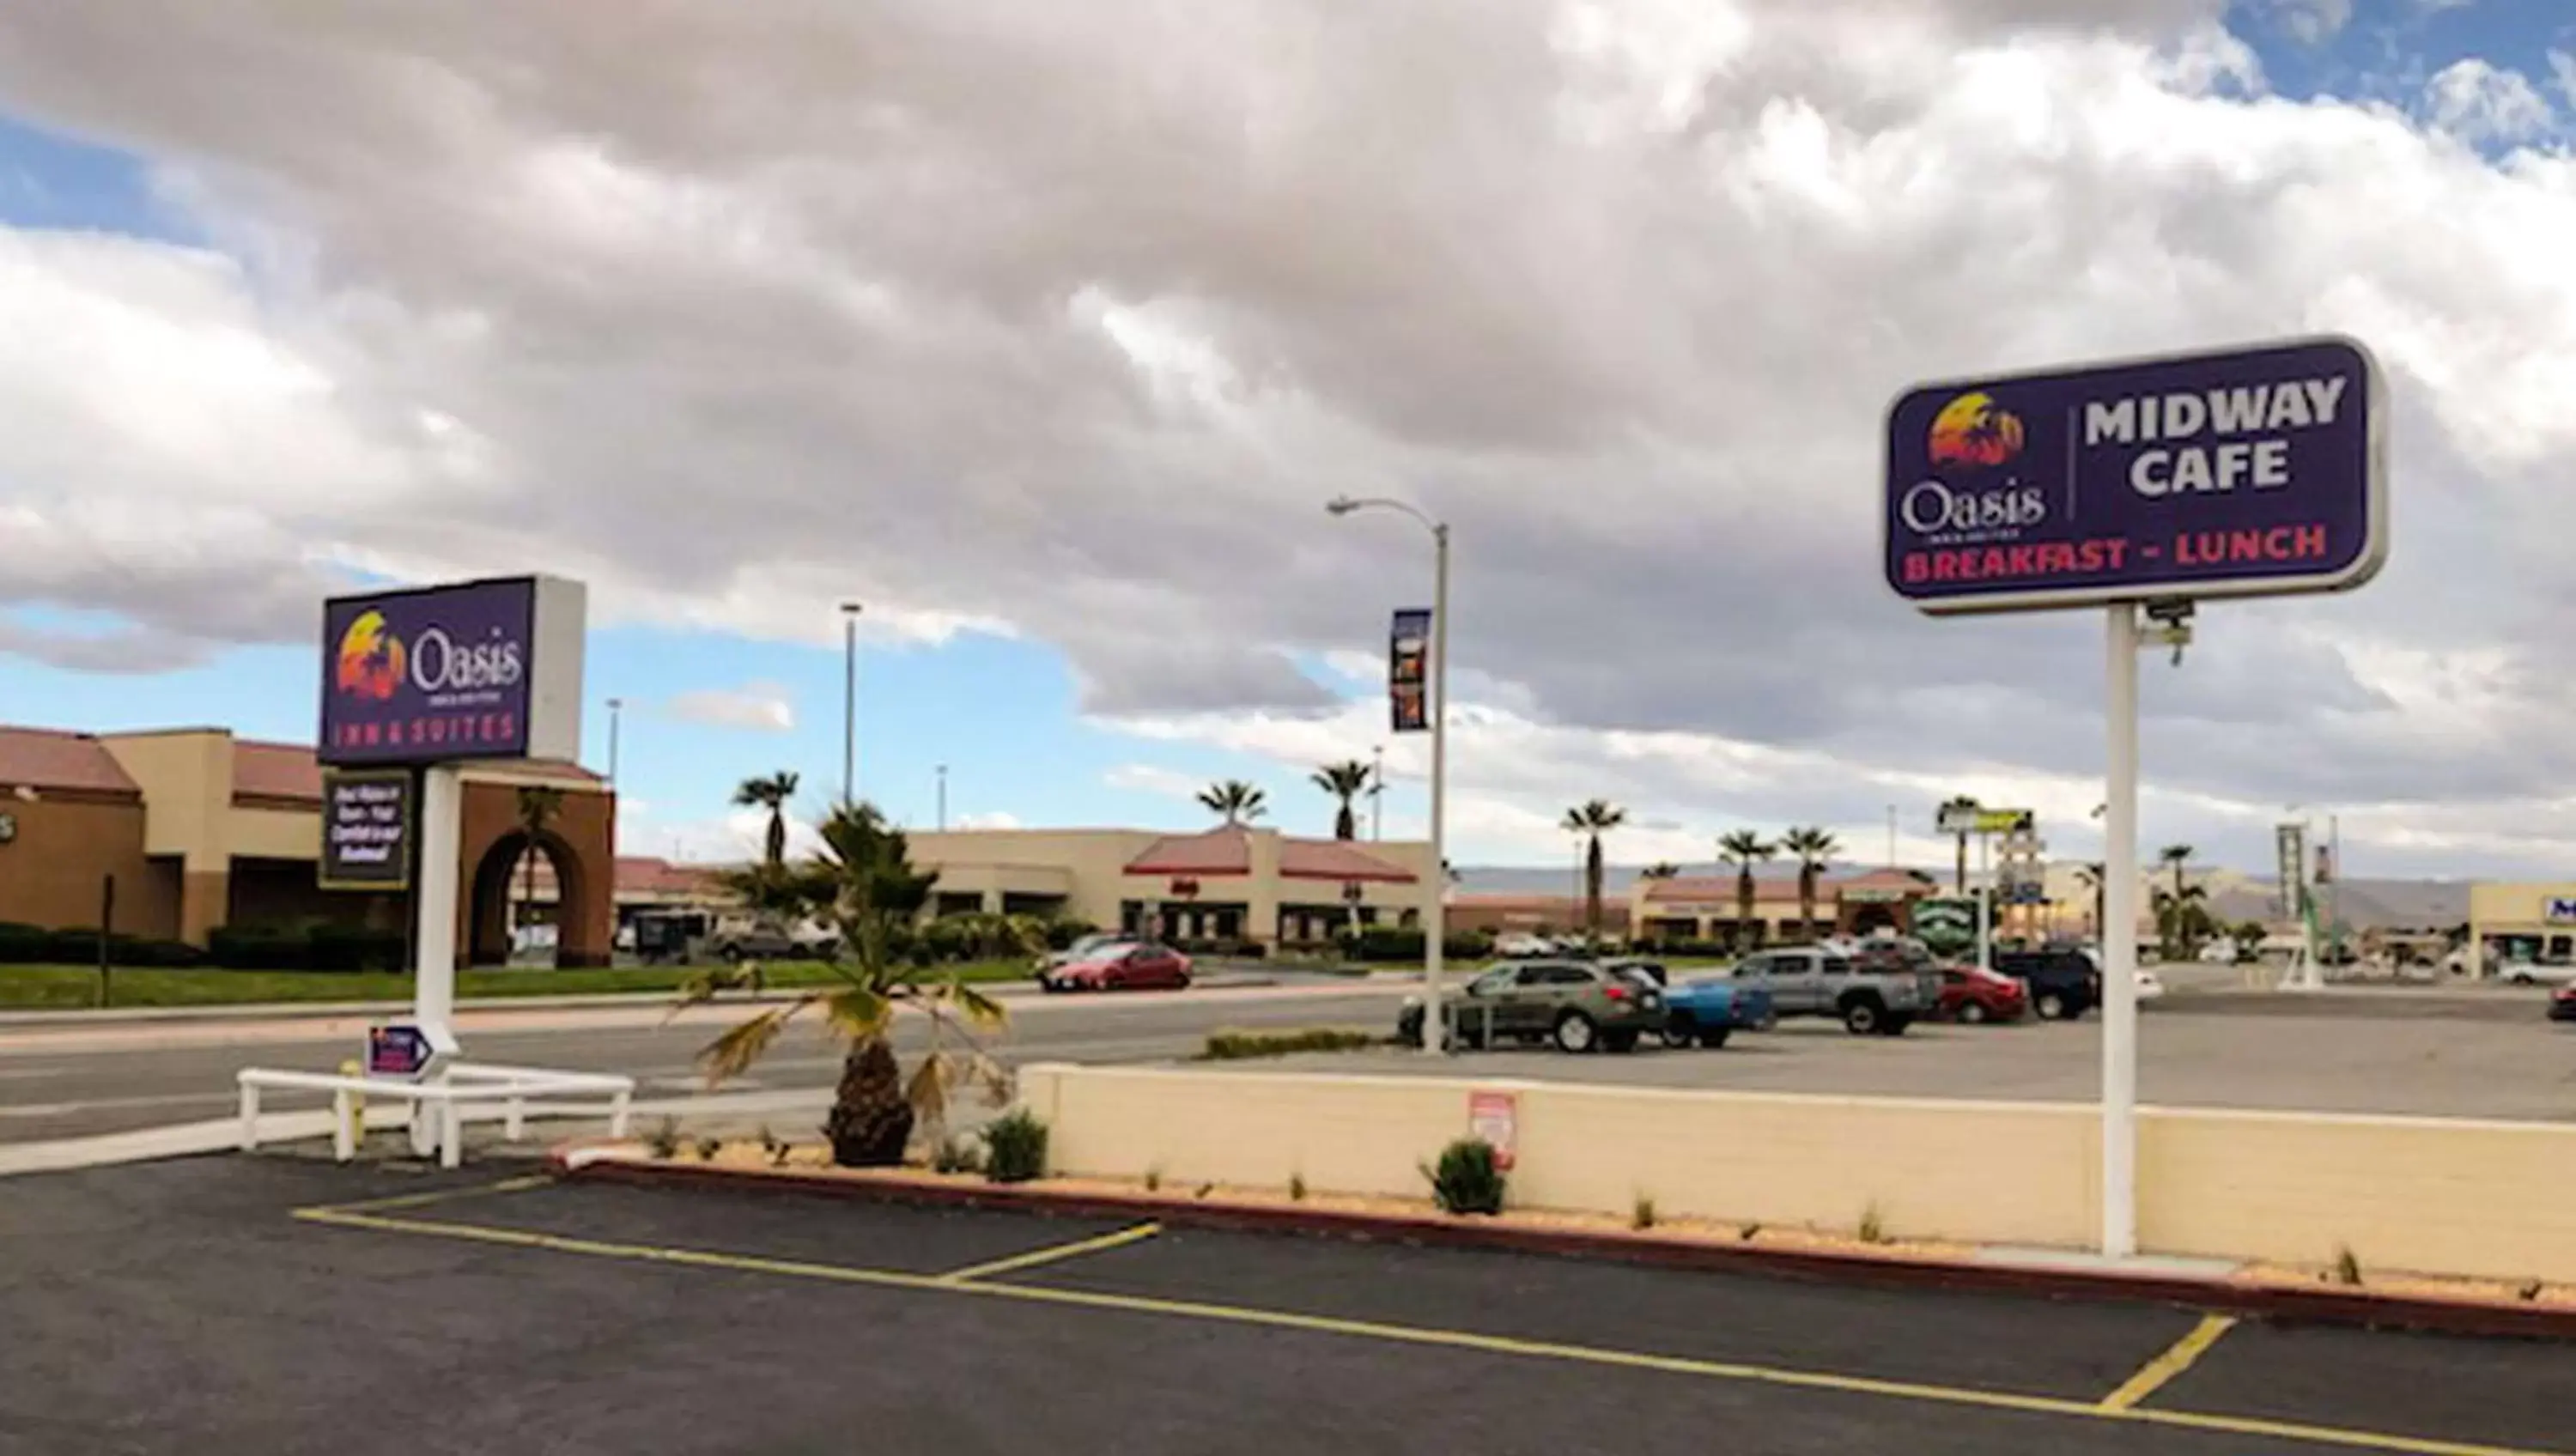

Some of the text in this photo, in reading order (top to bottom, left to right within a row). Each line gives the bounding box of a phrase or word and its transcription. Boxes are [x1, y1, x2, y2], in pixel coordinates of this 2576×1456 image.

[2085, 377, 2345, 445] MIDWAY
[2131, 440, 2287, 494] CAFE
[1903, 477, 2045, 532] Oasis
[1905, 540, 2128, 581] BREAKFAST
[2175, 525, 2324, 564] LUNCH
[412, 628, 520, 689] Oasis
[335, 723, 378, 747] INN
[411, 713, 513, 743] SUITES
